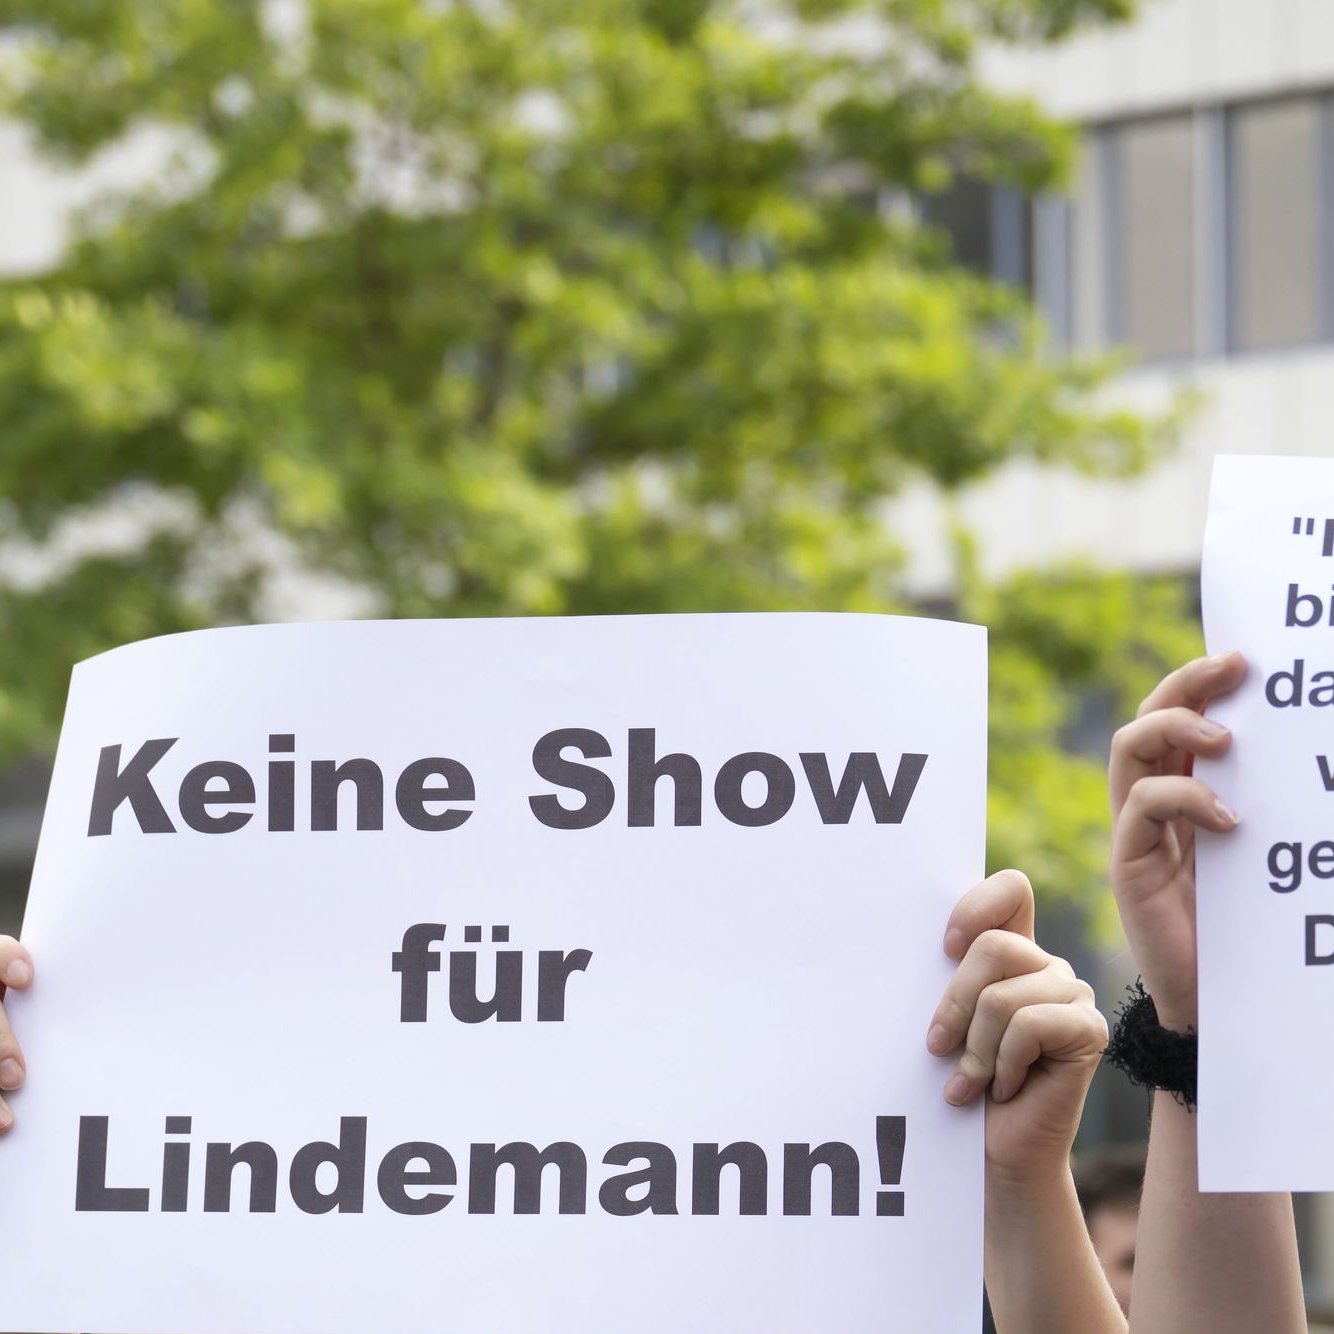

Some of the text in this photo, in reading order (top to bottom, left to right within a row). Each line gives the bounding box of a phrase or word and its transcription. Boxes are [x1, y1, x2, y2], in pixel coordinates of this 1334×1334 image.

[87, 728, 928, 837] Keine Show
[392, 923, 593, 1024] für
[75, 1116, 906, 1216] Lindemann!
